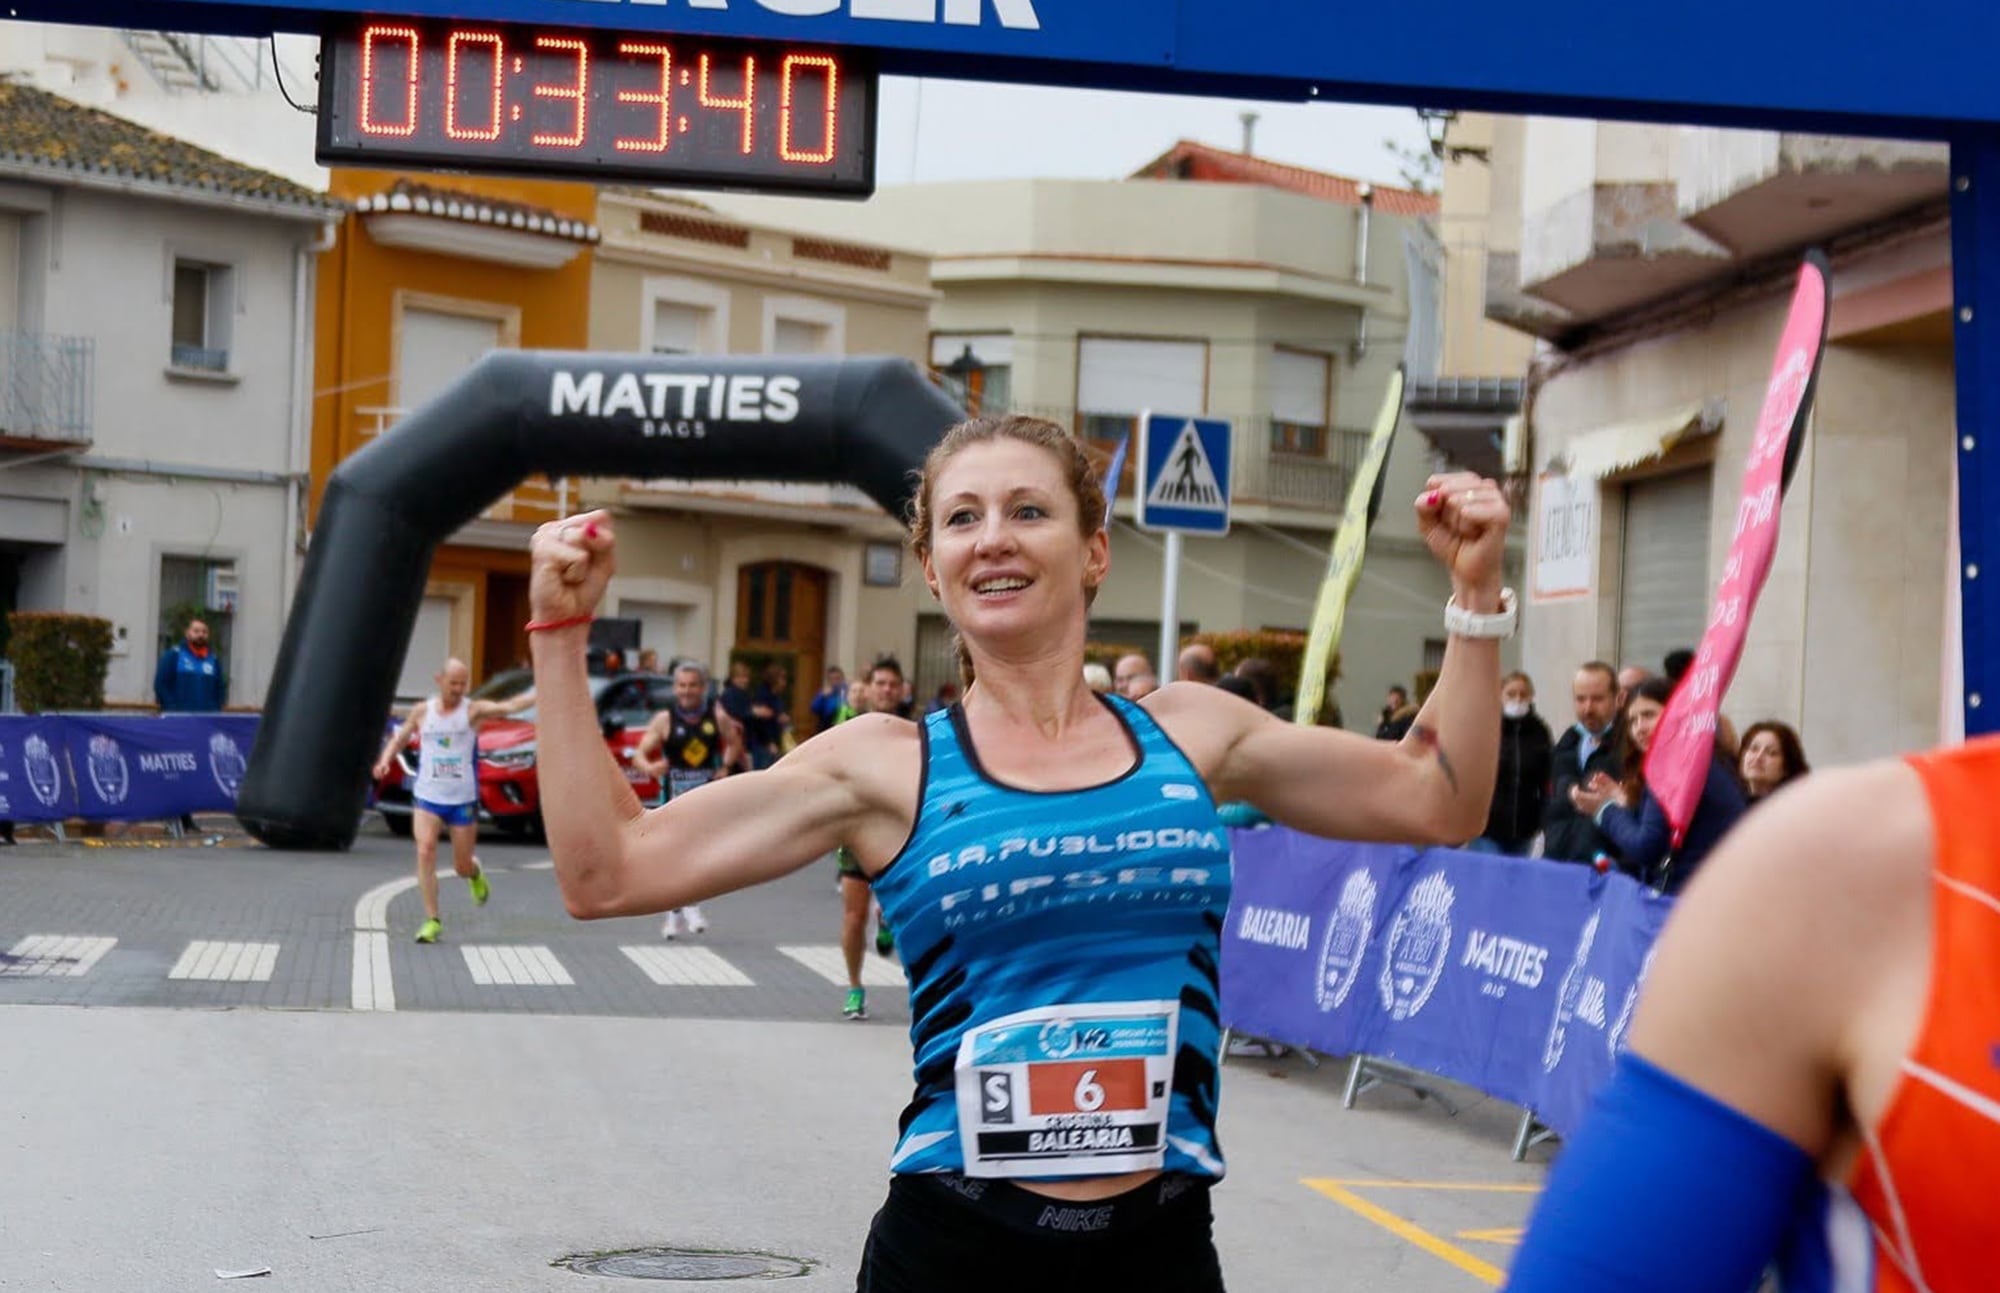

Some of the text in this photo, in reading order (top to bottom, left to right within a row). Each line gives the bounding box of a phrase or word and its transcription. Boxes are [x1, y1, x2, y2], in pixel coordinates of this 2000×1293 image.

[362, 26, 837, 162] 00:33:40
[551, 371, 801, 422] MATTIES
[643, 420, 707, 438] BAGS
[140, 753, 197, 772] MATTIES
[941, 867, 1210, 910] FIPSER
[1239, 905, 1310, 951] BALEARIA
[985, 1074, 1010, 1113] S
[1073, 1069, 1106, 1112] 6
[1029, 1126, 1134, 1152] BALEARIA
[1037, 1205, 1114, 1231] NIKE
